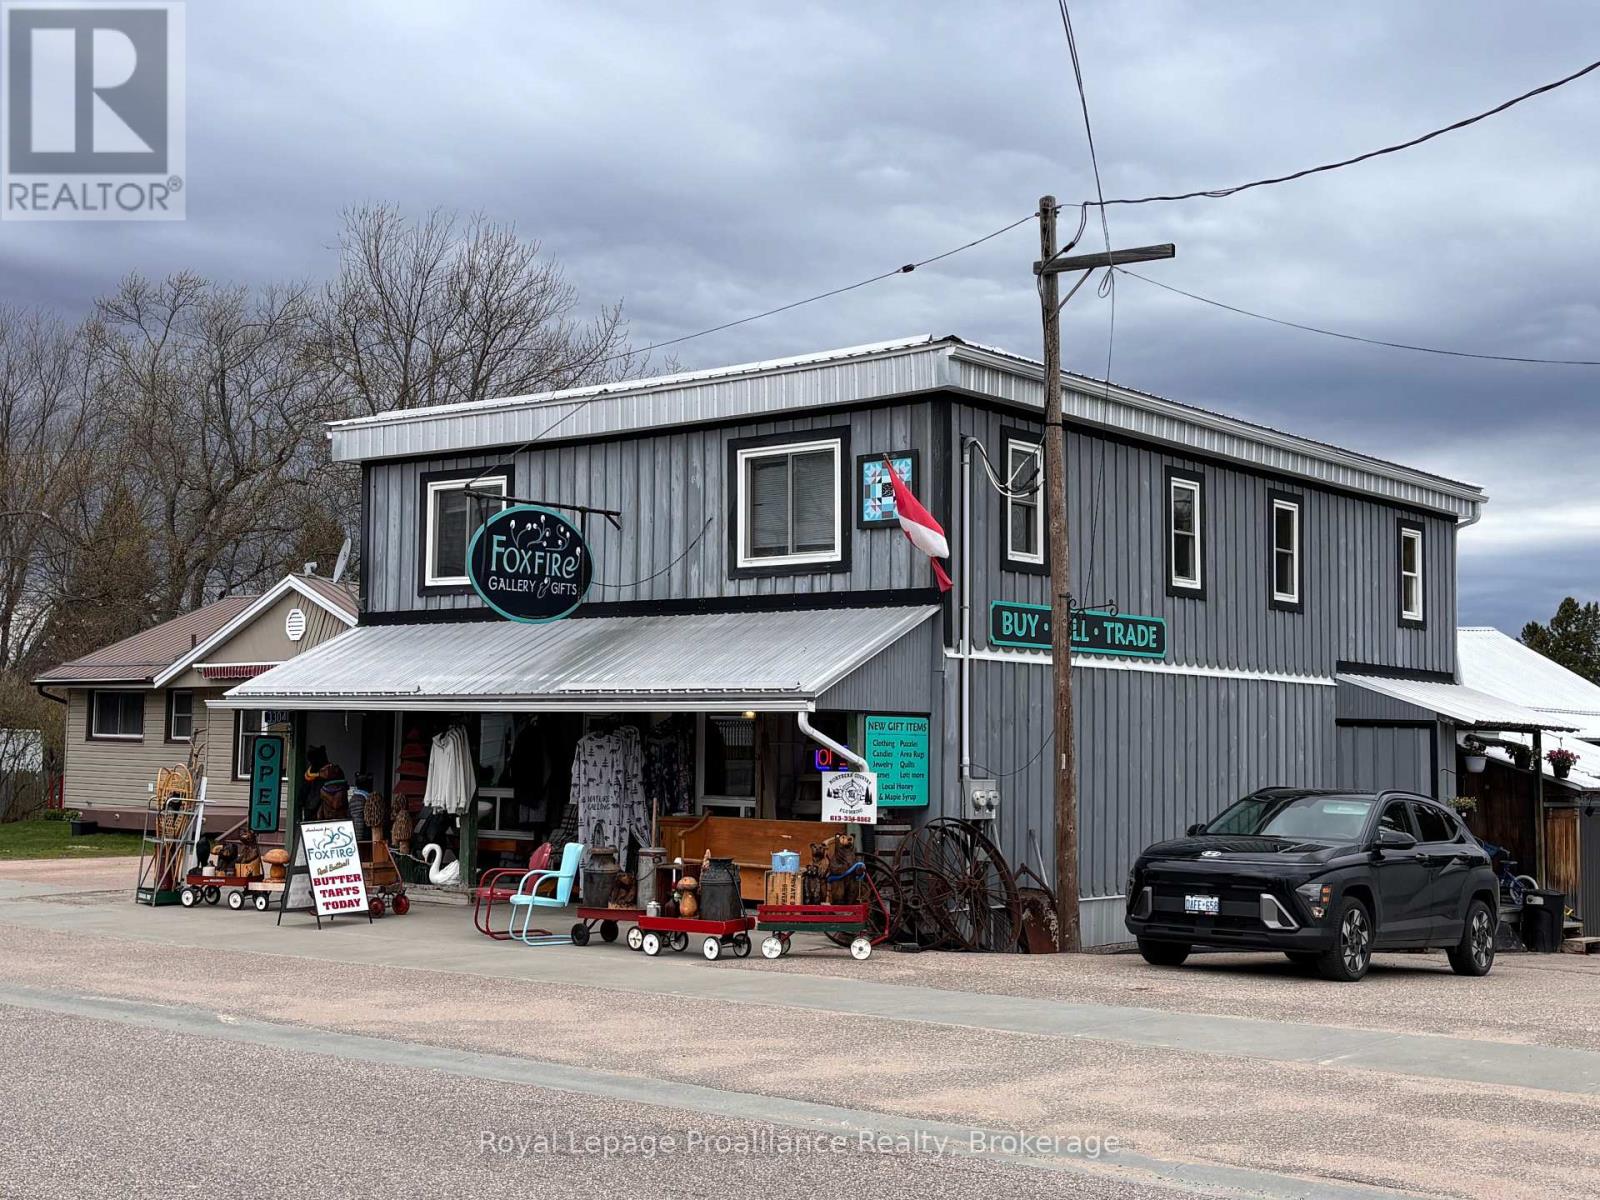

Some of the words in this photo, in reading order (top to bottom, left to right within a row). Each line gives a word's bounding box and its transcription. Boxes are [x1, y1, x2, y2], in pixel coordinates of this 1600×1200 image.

[488, 576, 536, 593] GALLERY
[551, 581, 578, 596] GIFTS
[1001, 610, 1039, 638] BUY
[1103, 621, 1157, 648] TRADE
[868, 721, 885, 731] NEW
[887, 721, 904, 731] GIFT
[906, 722, 927, 732] ITEMS
[872, 739, 895, 748] Clothing
[872, 761, 893, 769] Jewelry
[899, 760, 915, 769] Quilts
[256, 743, 276, 828] OPEN
[884, 793, 902, 801] Maple
[313, 873, 362, 886] BUTTER
[320, 886, 360, 898] TARTS
[322, 898, 361, 910] TODAY
